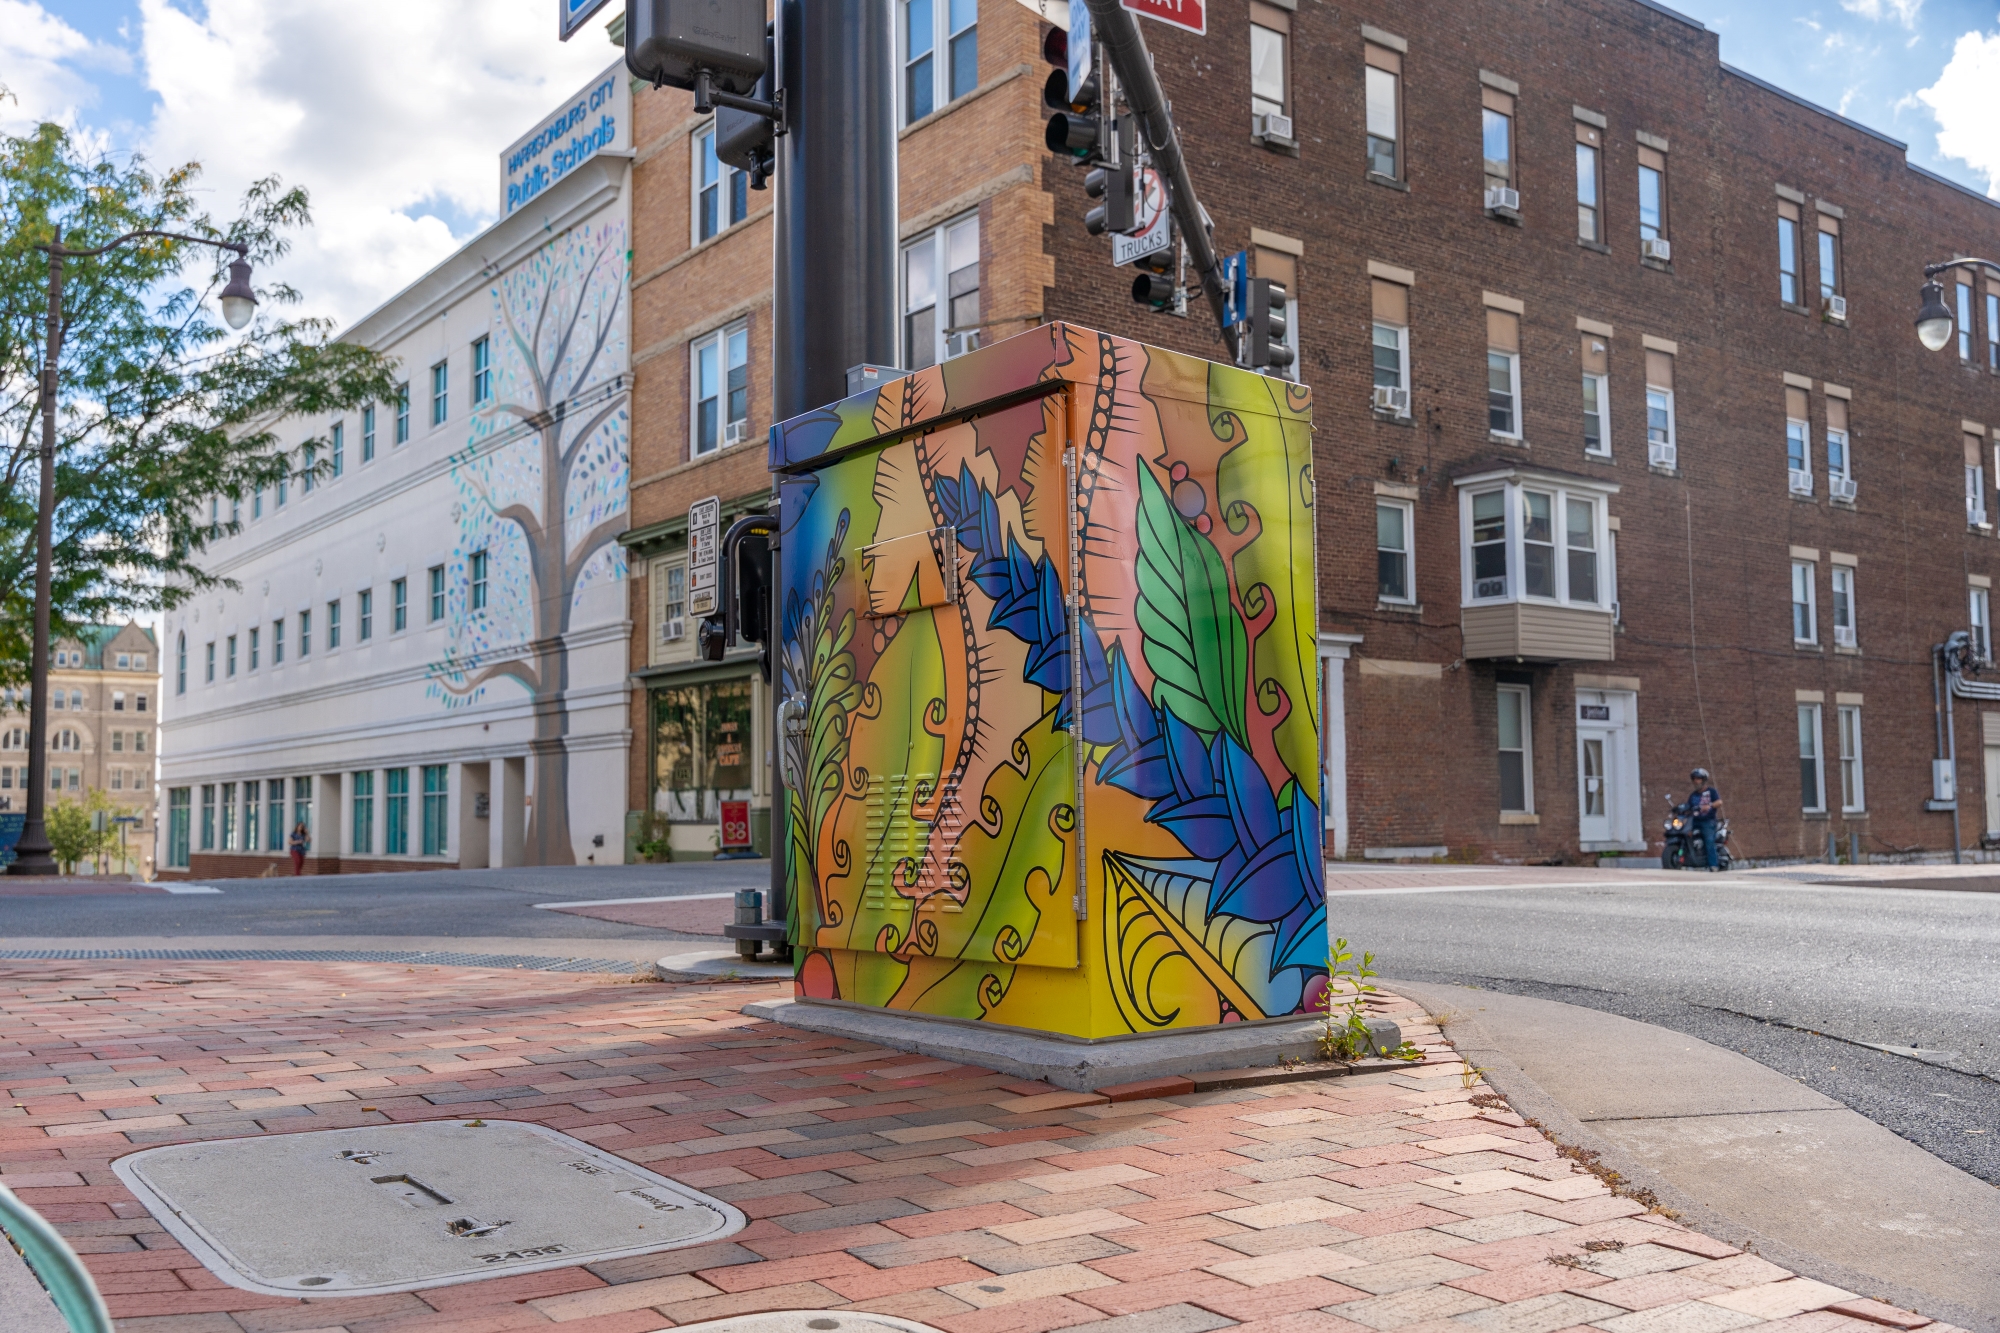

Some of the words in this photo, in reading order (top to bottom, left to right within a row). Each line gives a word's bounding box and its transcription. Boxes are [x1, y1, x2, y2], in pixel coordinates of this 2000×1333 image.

[507, 163, 549, 214] Public
[551, 114, 615, 181] Schools
[508, 101, 587, 176] HARRISONBURG
[589, 75, 615, 112] CITY
[1121, 230, 1163, 259] TRUCKS
